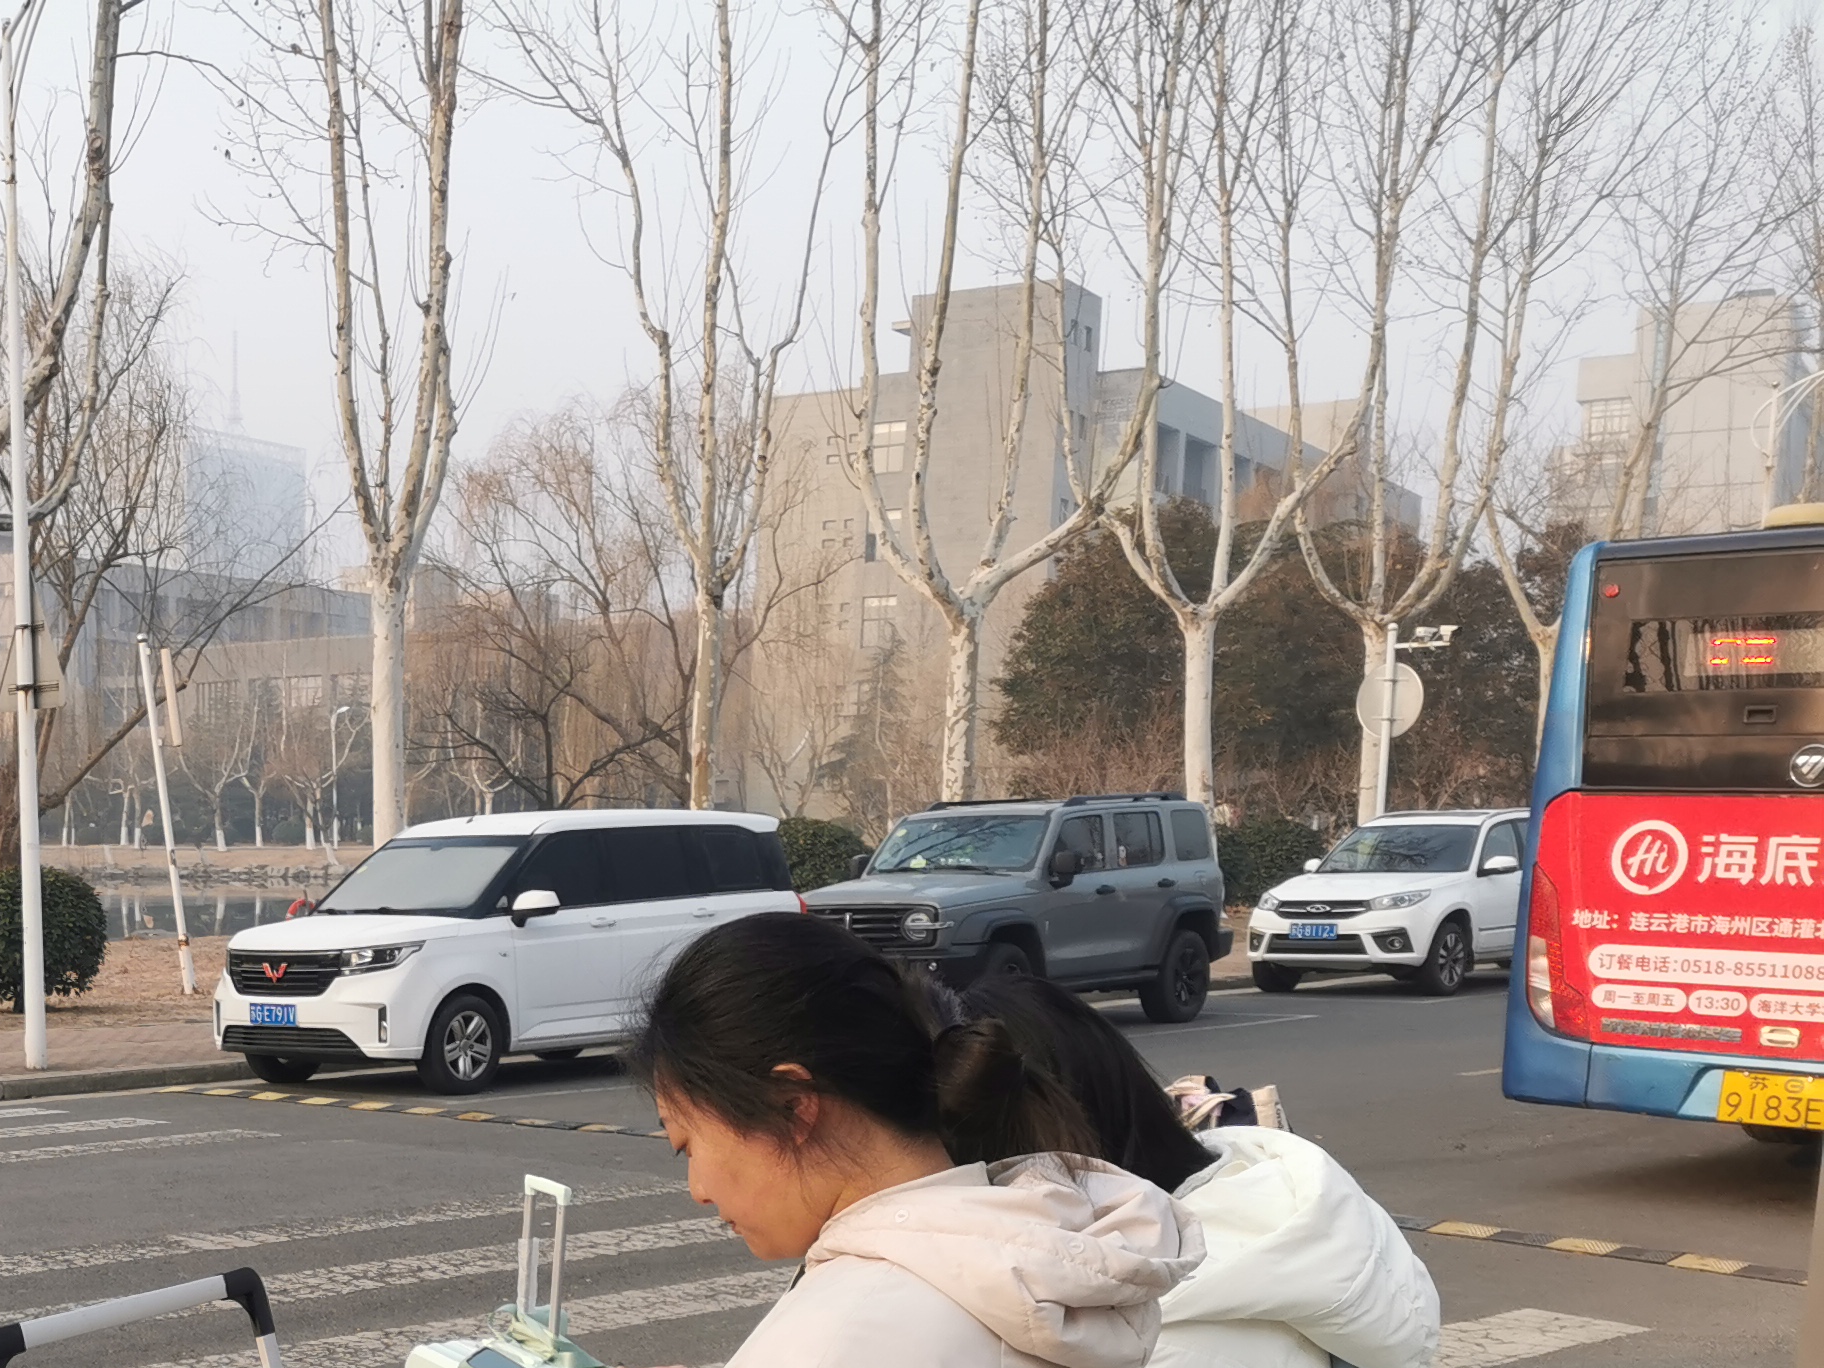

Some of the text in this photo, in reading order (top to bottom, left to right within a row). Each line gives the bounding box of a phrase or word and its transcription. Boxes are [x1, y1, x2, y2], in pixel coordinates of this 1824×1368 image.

[1697, 833, 1822, 887] 海底
[1602, 990, 1824, 1017] 周一至周五 13:30 海洋大学
[1725, 1092, 1824, 1125] 9183E
